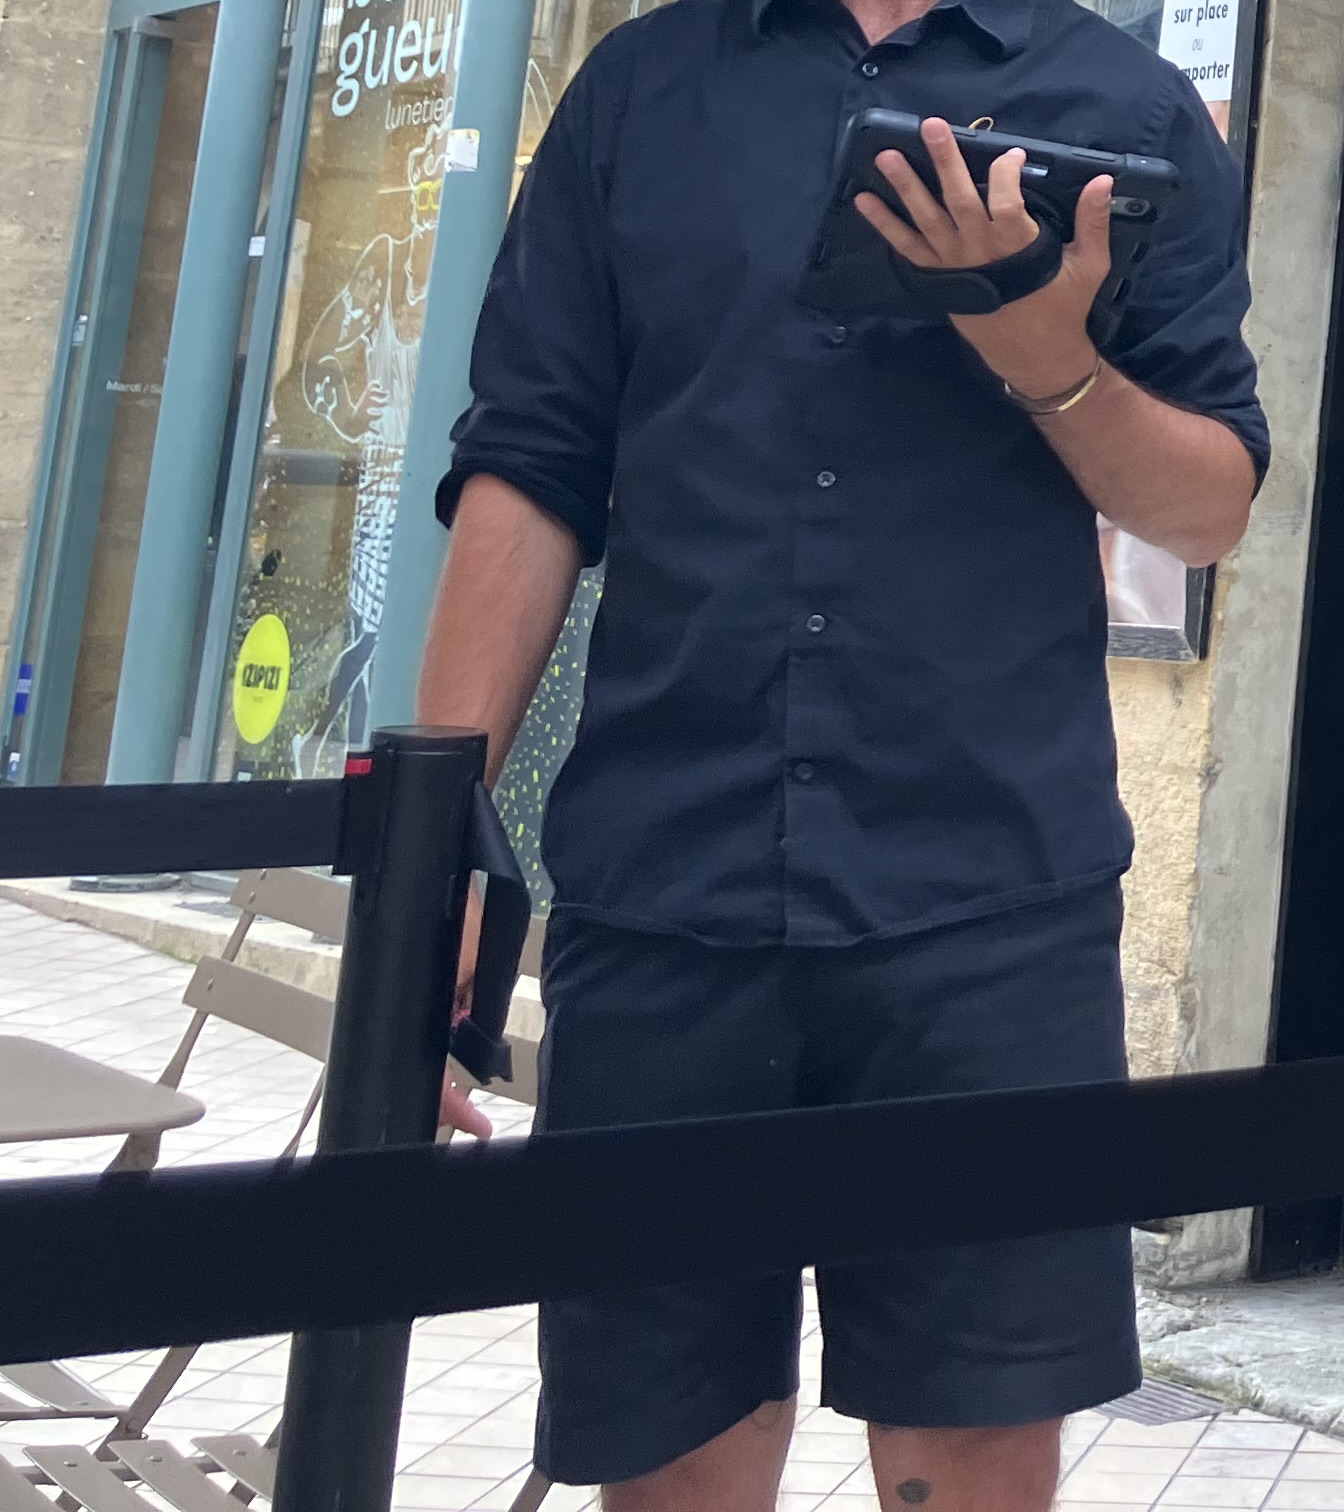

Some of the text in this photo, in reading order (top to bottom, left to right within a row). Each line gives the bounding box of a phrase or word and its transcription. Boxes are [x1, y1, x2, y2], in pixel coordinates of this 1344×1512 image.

[1174, 7, 1193, 24] sur
[1191, 38, 1205, 52] ou
[331, 13, 462, 118] gueu
